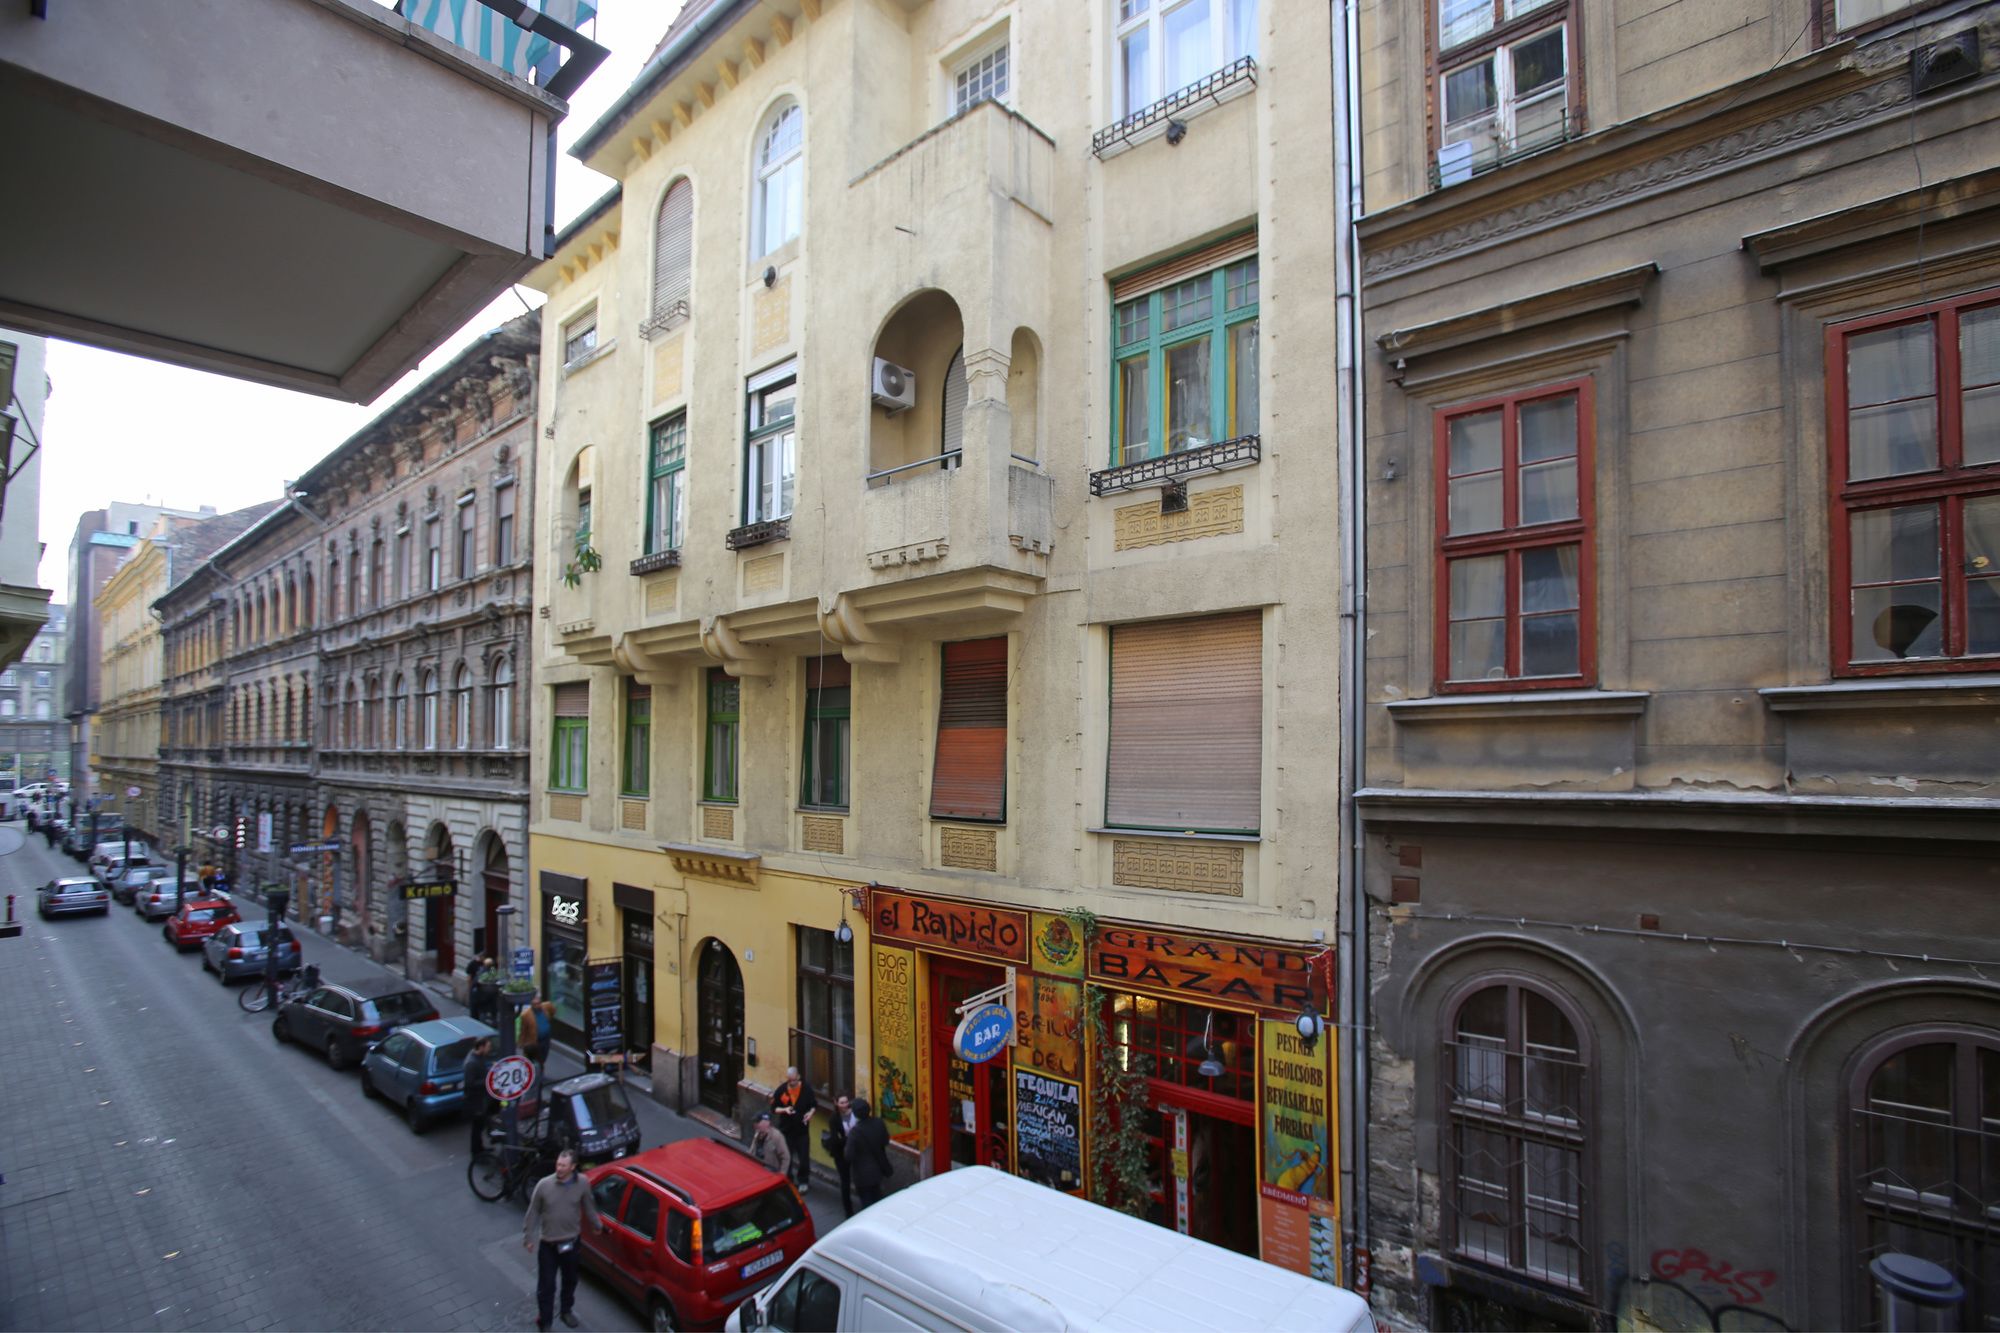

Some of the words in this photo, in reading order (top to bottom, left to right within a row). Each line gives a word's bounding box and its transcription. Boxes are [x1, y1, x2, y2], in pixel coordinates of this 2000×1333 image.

[880, 901, 899, 930] el
[911, 900, 1019, 946] Rapido
[1104, 931, 1312, 973] GRAND
[1100, 953, 1314, 1006] BAZAR
[975, 1024, 1001, 1047] BAR
[501, 1069, 523, 1087] 20
[1017, 1073, 1078, 1105] TEQUILA
[1016, 1100, 1067, 1125] MEXICAN
